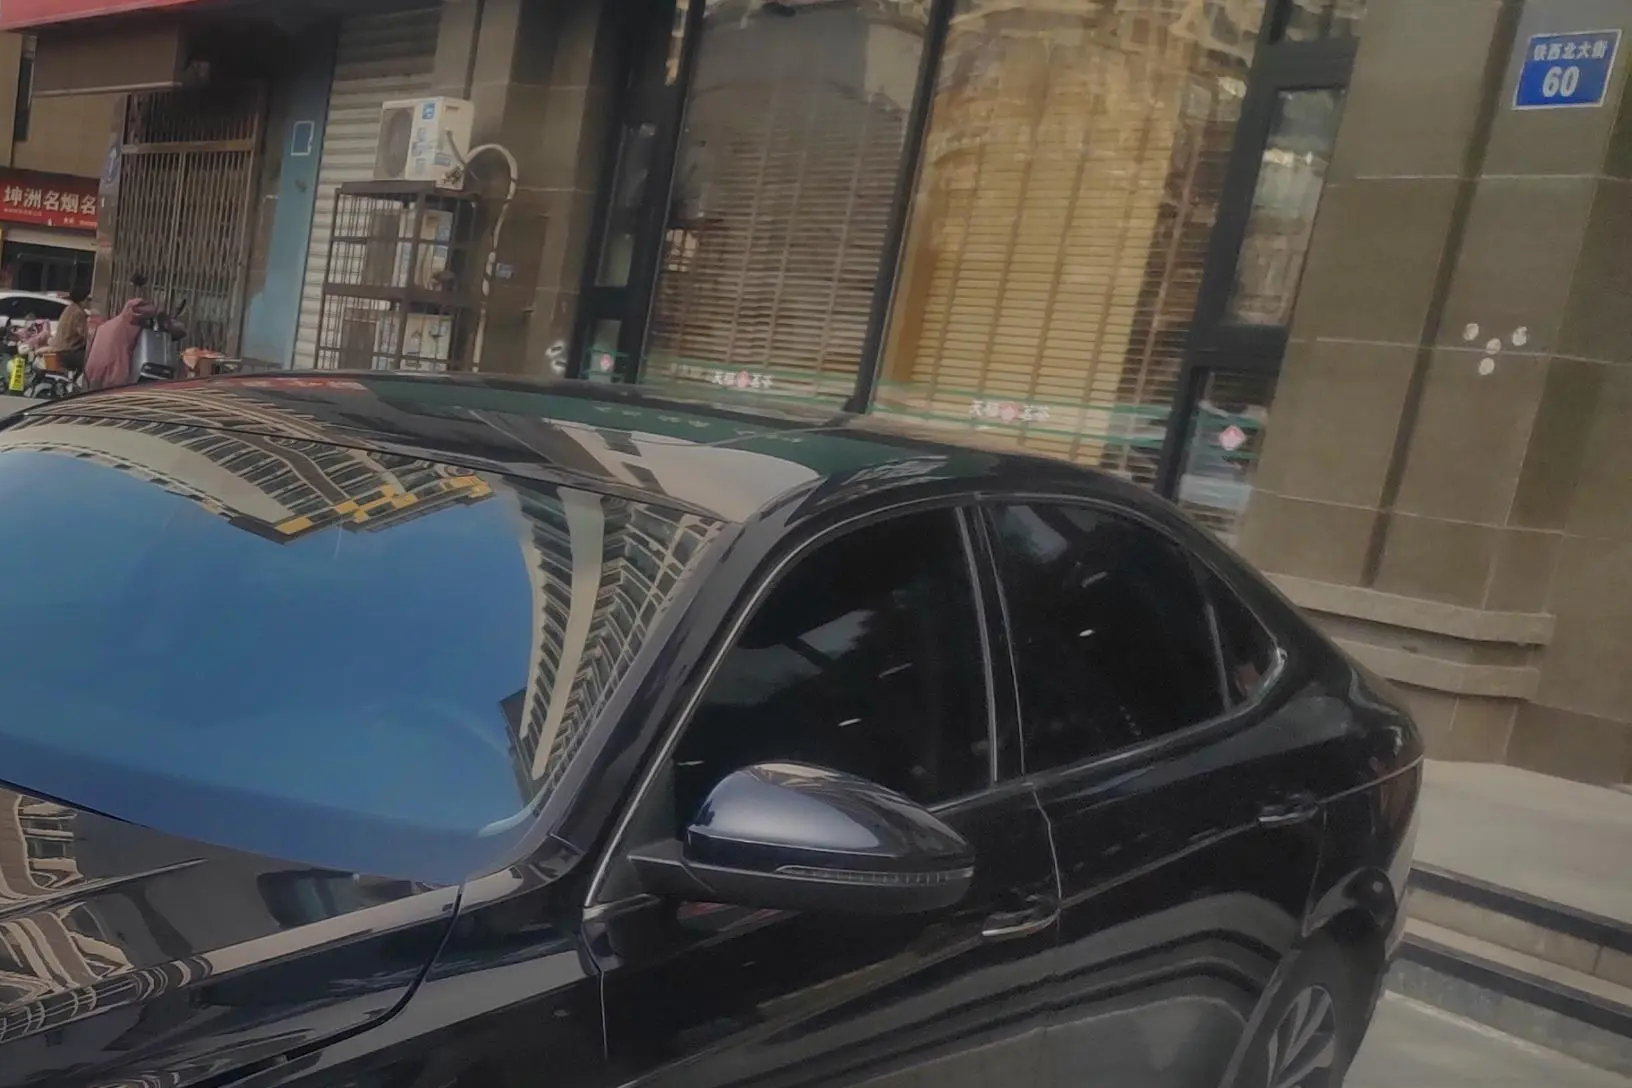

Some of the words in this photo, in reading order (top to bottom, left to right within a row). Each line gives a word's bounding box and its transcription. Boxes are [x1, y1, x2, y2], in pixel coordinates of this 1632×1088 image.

[1542, 66, 1580, 97] 60
[3, 185, 97, 215] 坤洲名烟名
